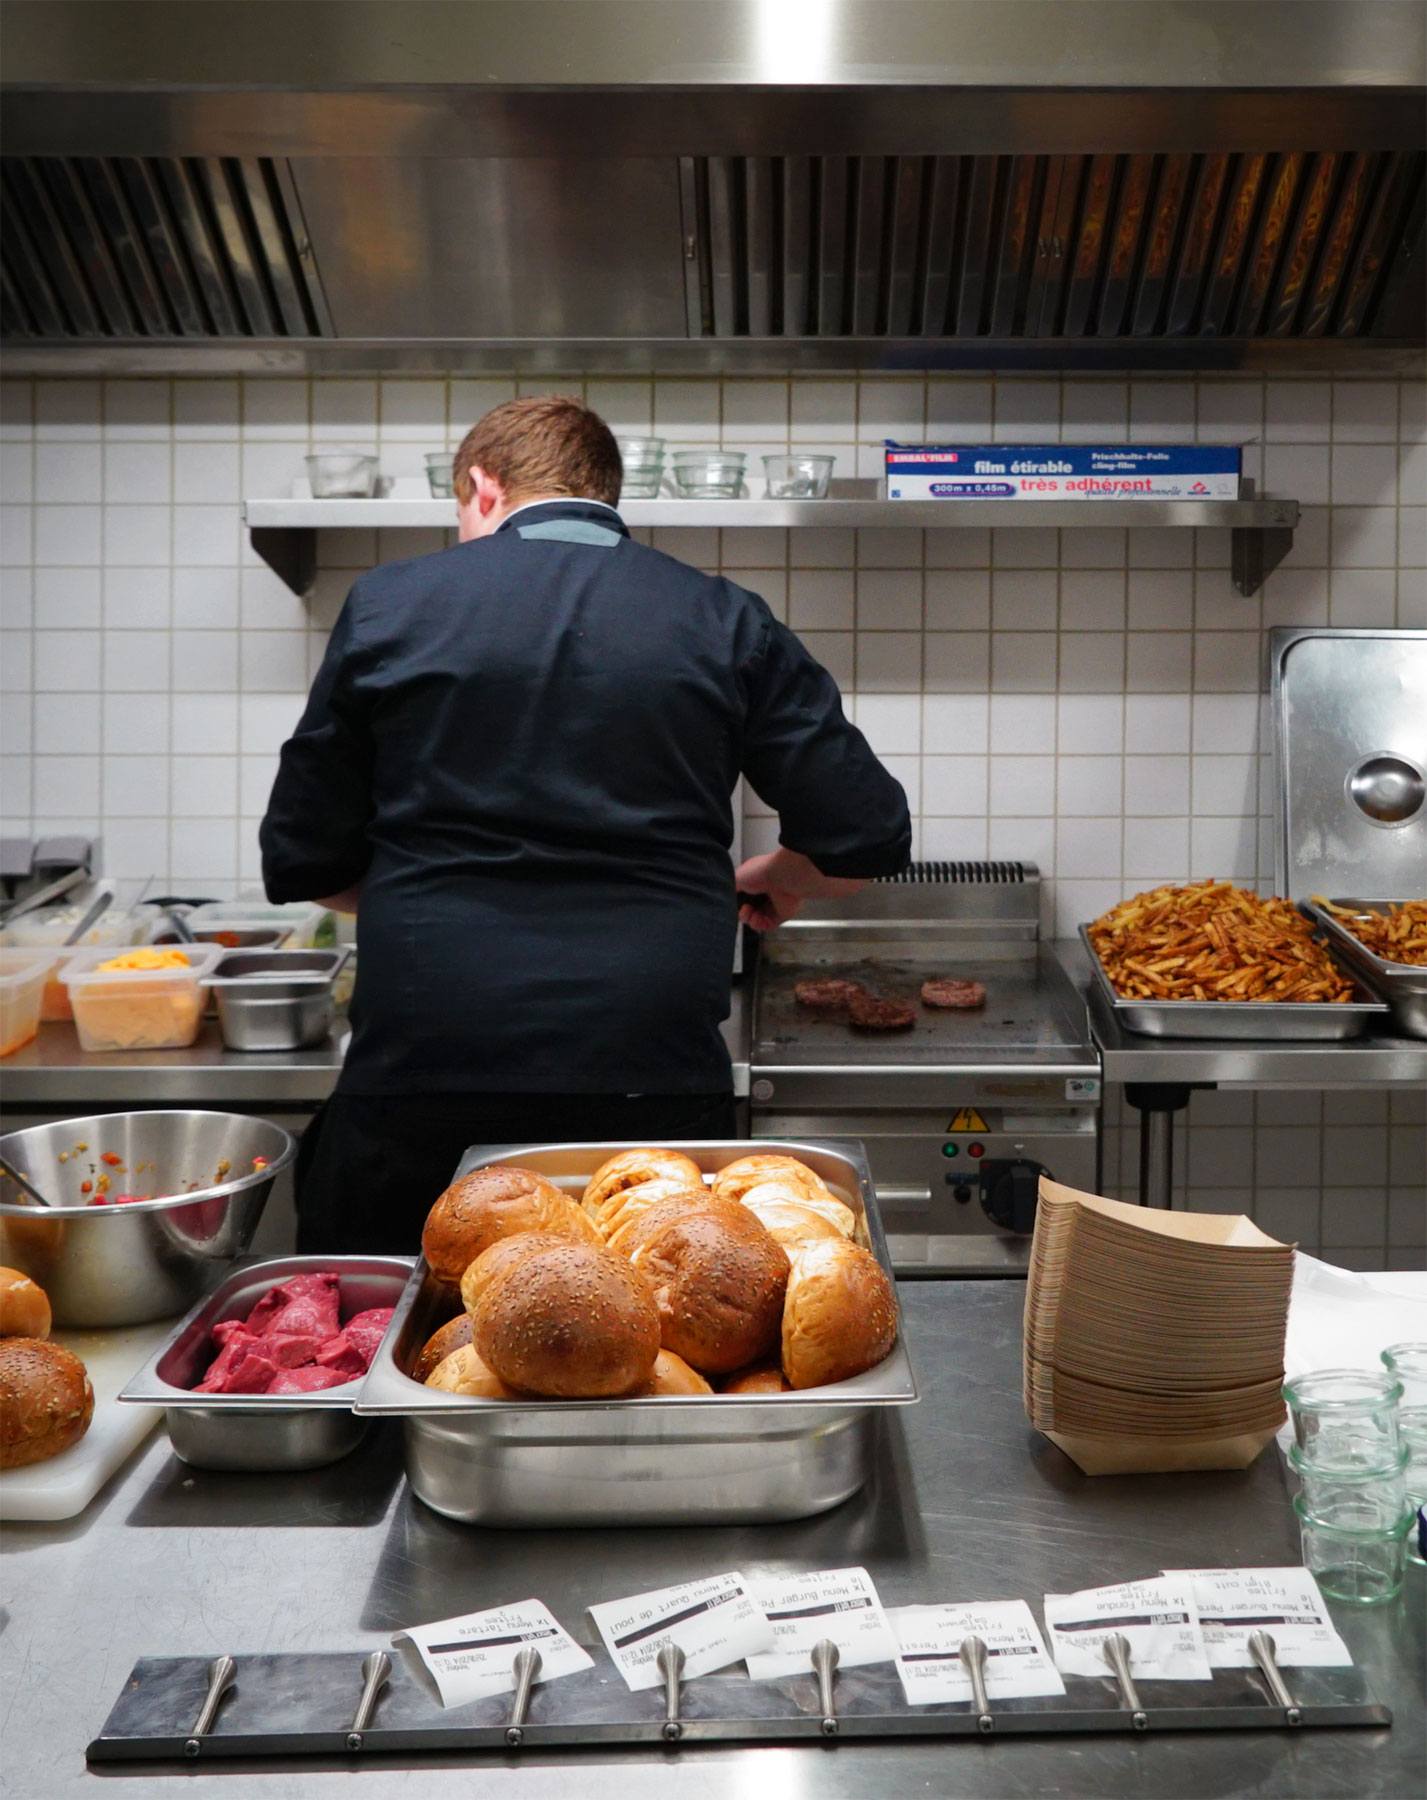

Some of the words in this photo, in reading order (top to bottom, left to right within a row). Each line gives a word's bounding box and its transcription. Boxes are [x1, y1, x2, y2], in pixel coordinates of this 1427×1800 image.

[974, 460, 1006, 474] film
[1010, 460, 1073, 474] étirable
[1091, 462, 1136, 471] cling-film
[933, 484, 963, 493] 300m
[974, 484, 1007, 494] 0,45m
[1020, 477, 1058, 492] très
[1065, 477, 1153, 492] adhérent
[821, 1586, 849, 1598] Menu
[658, 1595, 690, 1610] Quart
[781, 1591, 818, 1605] Burger
[1096, 1602, 1135, 1611] Fondue
[1196, 1603, 1224, 1614] Pers
[1229, 1603, 1268, 1613] Burger
[1272, 1603, 1299, 1612] Menu
[638, 1608, 653, 1621] de
[458, 1624, 503, 1636] Tartare
[506, 1620, 533, 1630] Menu
